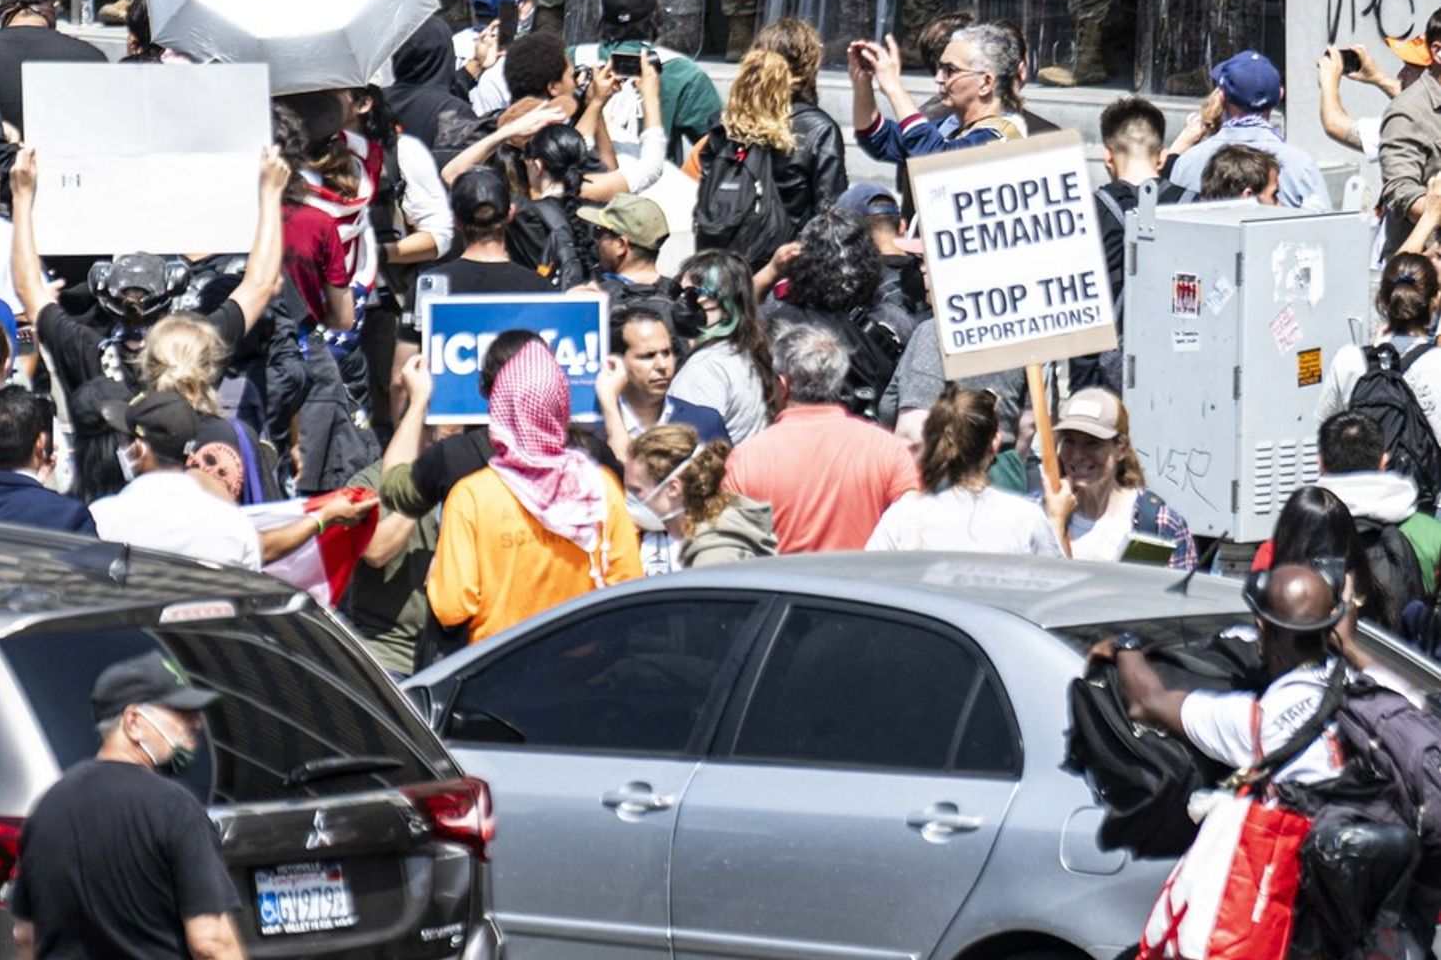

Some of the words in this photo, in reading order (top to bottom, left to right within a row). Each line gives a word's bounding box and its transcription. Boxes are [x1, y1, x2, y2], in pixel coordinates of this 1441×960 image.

[951, 171, 1082, 223] PEOPLE
[934, 208, 1087, 261] DEMAND:
[946, 283, 1029, 325] STOP
[1036, 270, 1100, 308] THE
[952, 304, 1103, 349] DEPORTATIONS!
